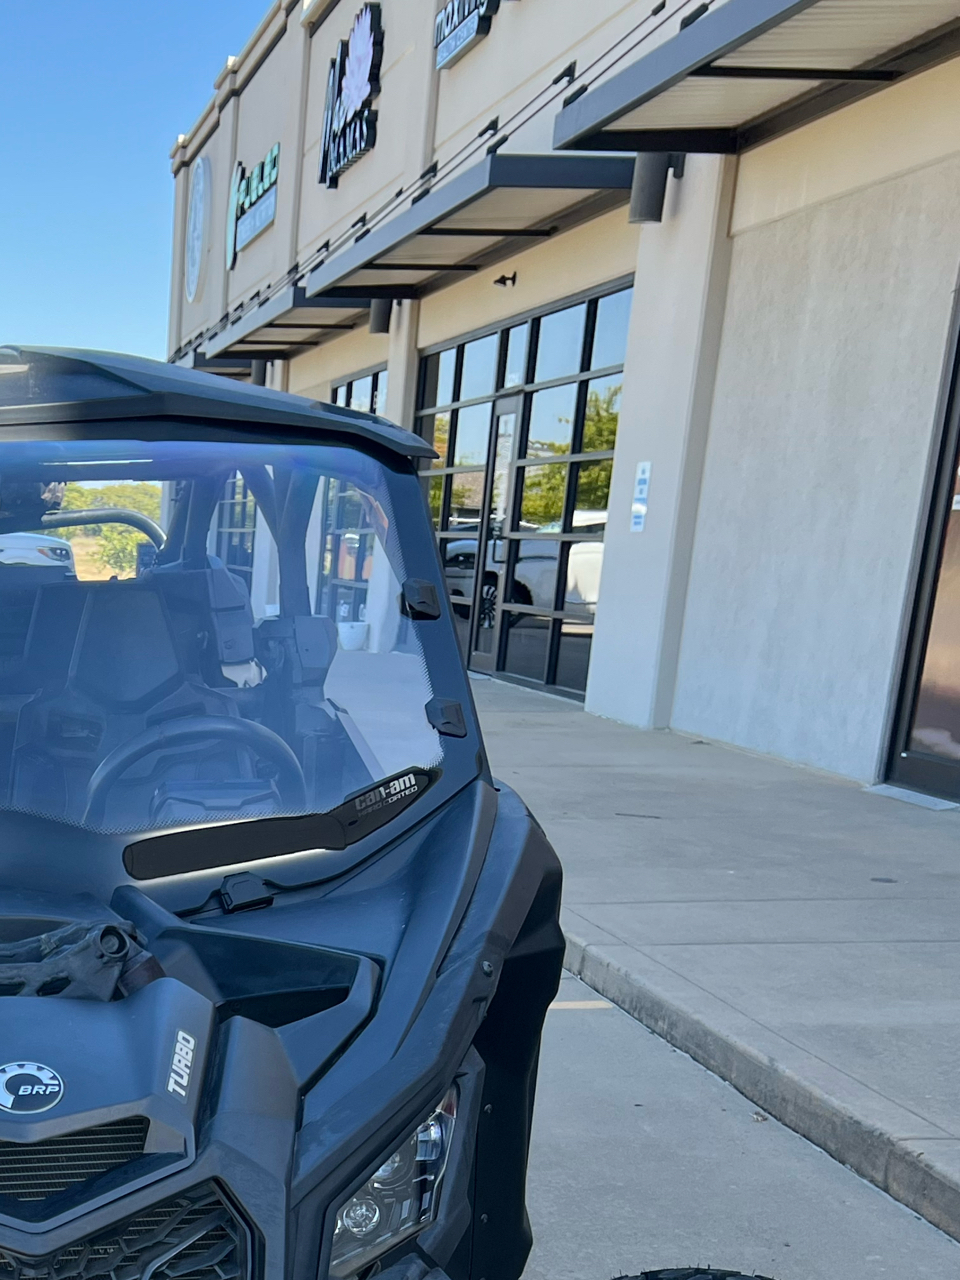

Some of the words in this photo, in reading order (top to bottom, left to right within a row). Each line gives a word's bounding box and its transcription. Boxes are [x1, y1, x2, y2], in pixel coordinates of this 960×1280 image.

[355, 773, 416, 810] can-am
[167, 1030, 195, 1097] TURBO
[18, 1085, 60, 1096] BRP
